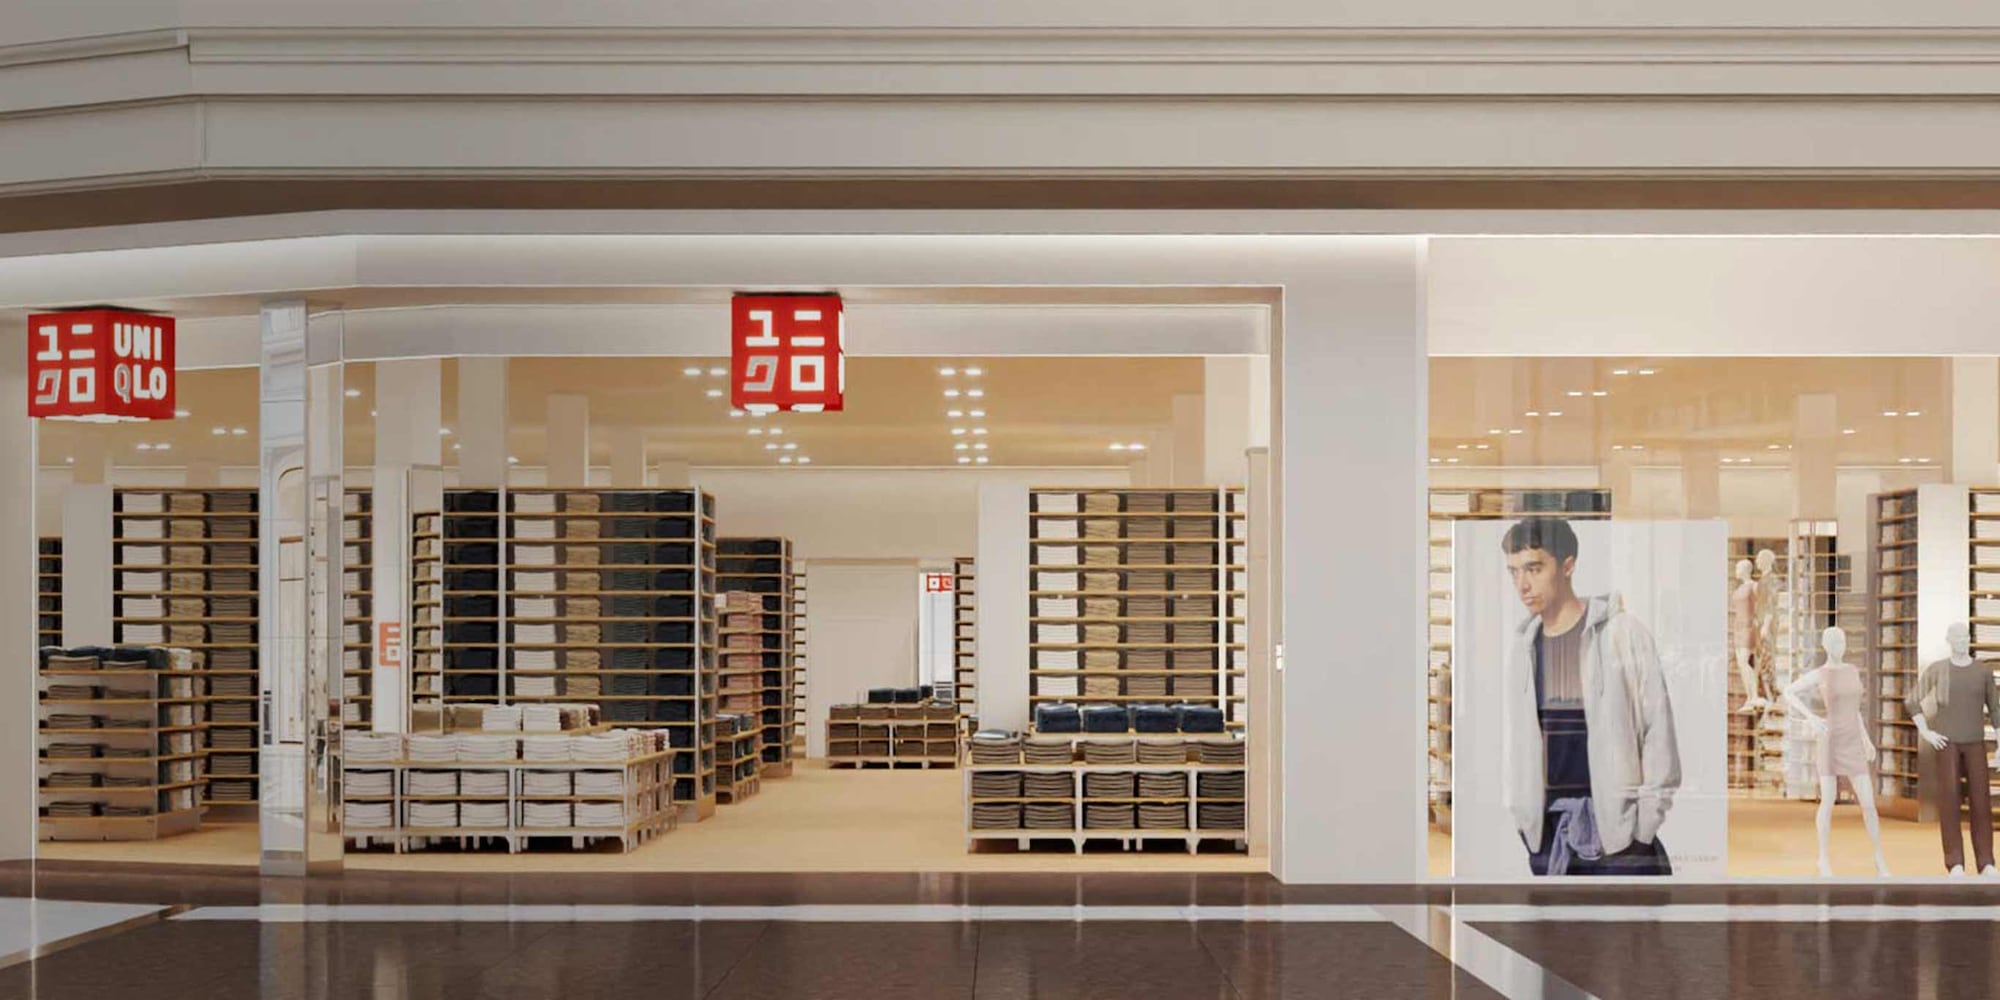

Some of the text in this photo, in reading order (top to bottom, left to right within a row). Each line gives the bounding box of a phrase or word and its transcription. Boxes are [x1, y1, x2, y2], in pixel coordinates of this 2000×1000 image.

[37, 324, 94, 361] ユニ
[114, 323, 162, 361] UNI
[744, 310, 825, 347] ユニ
[114, 363, 167, 404] QLO
